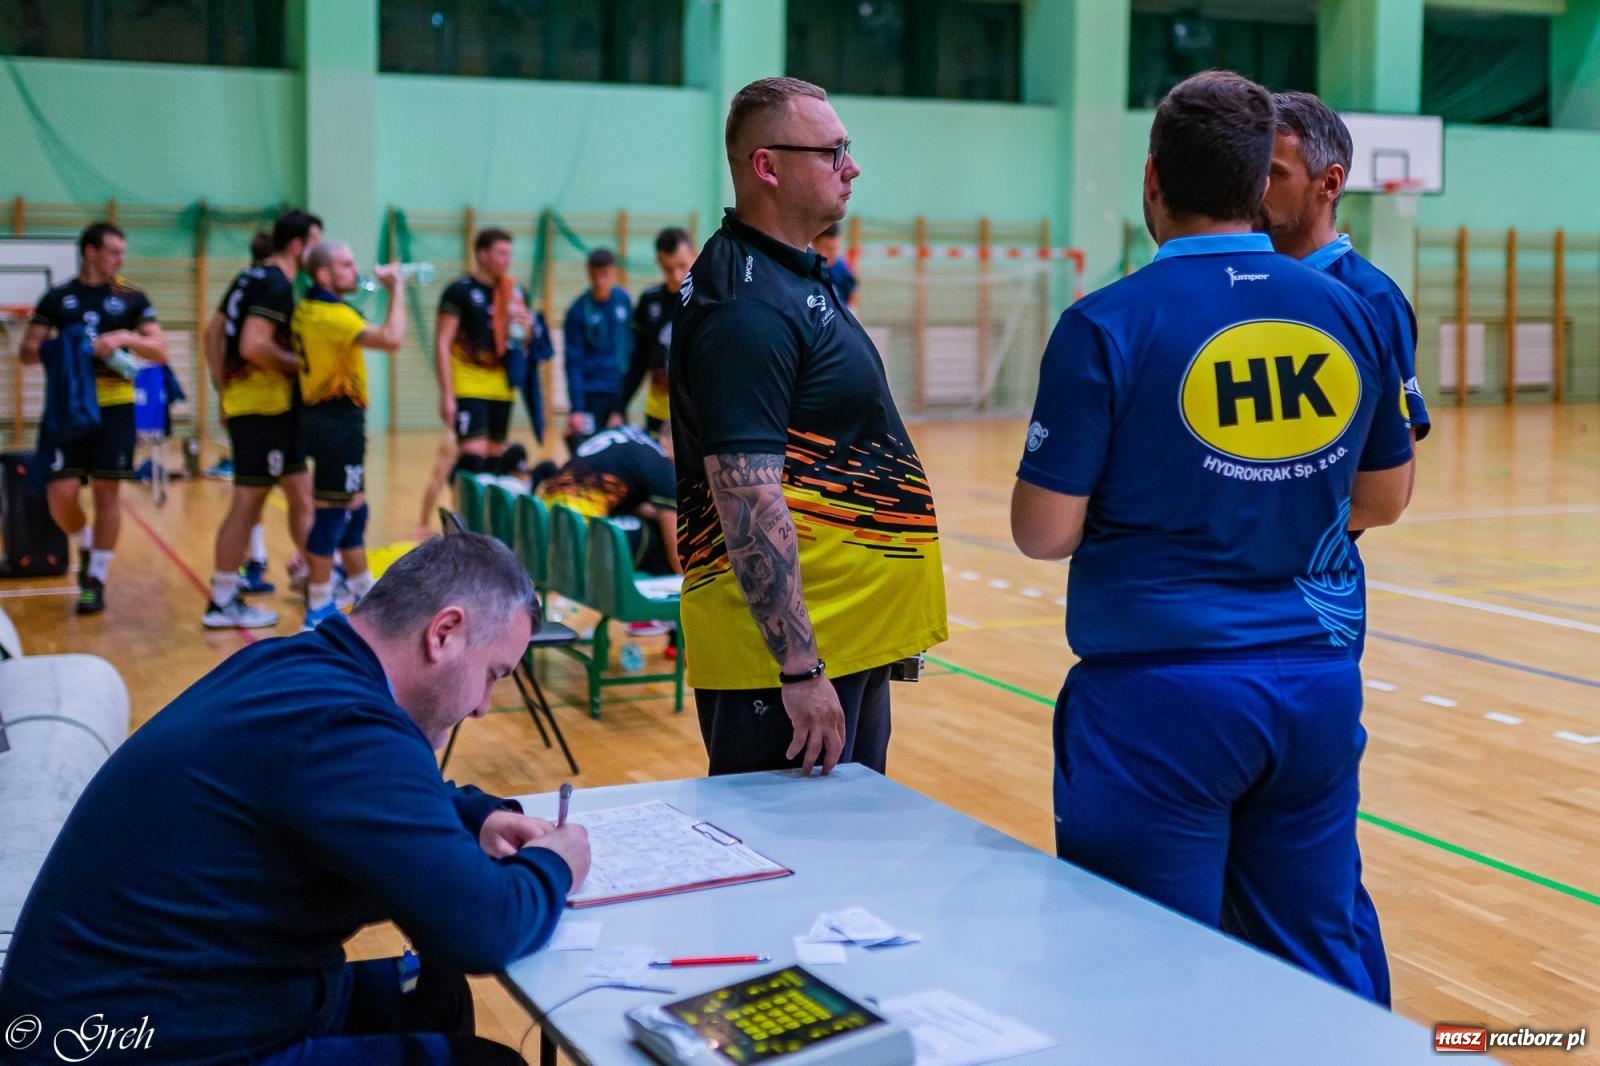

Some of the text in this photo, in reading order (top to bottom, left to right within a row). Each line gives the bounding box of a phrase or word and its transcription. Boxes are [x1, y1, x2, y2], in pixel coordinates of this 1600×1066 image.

[1214, 353, 1337, 428] HK
[1203, 446, 1348, 482] HYDROKRAK Sp. z o.o.
